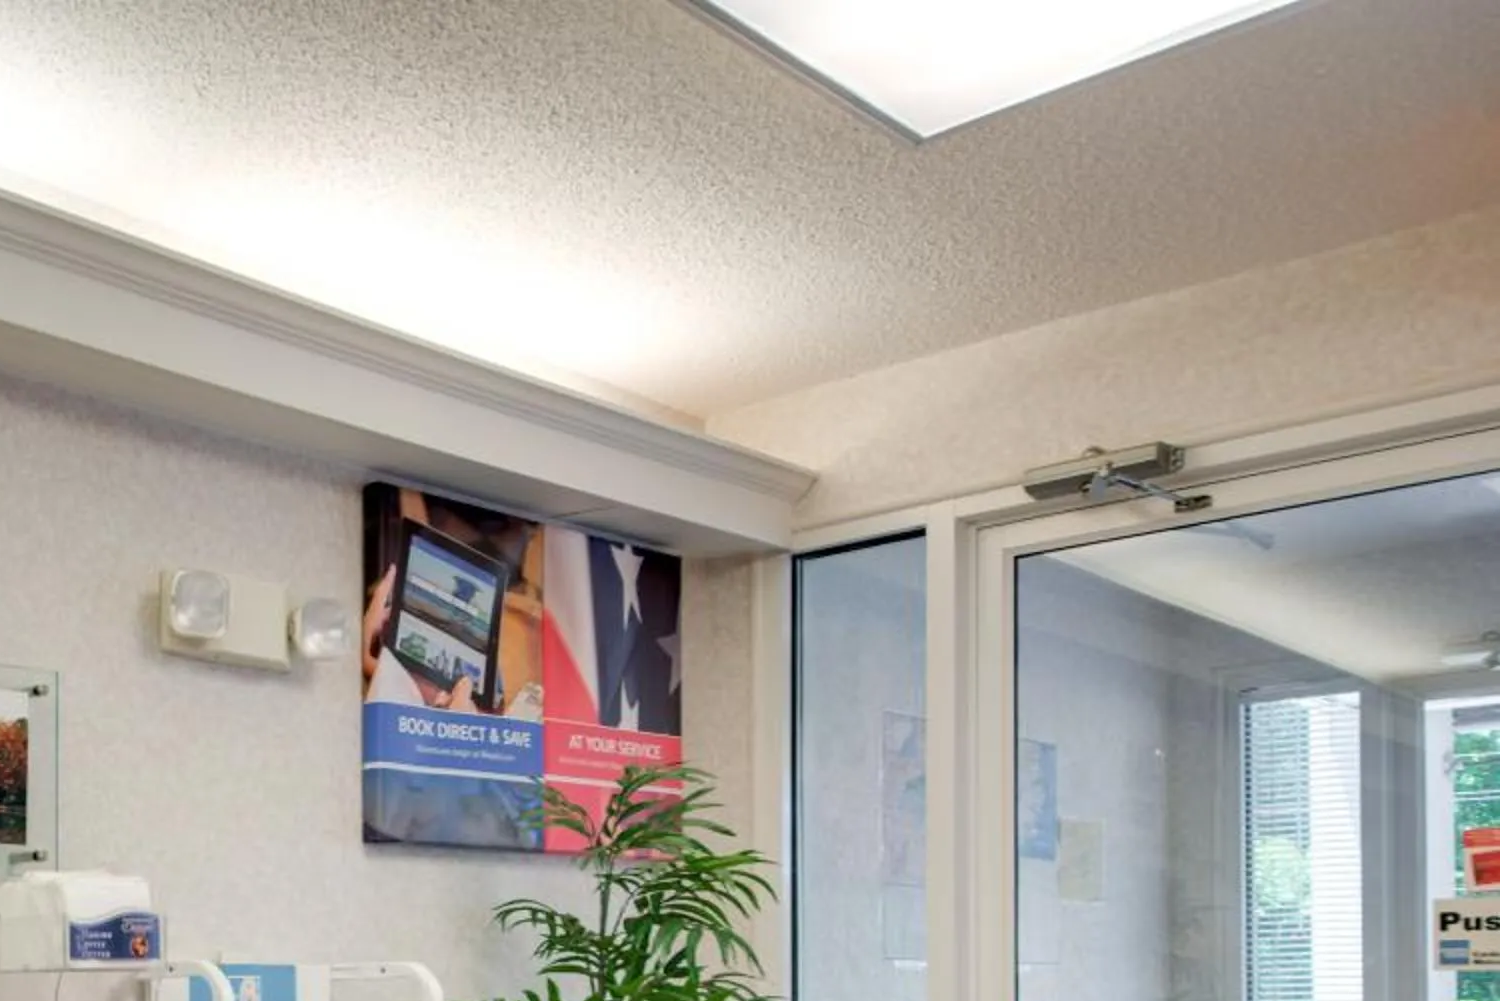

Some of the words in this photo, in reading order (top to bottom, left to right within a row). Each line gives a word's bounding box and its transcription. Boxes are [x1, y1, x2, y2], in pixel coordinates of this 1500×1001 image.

[398, 715, 435, 736] BOOK
[437, 721, 486, 742] DIRECT
[503, 729, 532, 749] SAVE
[568, 734, 584, 750] AT
[584, 736, 617, 754] YOUR
[617, 740, 663, 760] SERVICE
